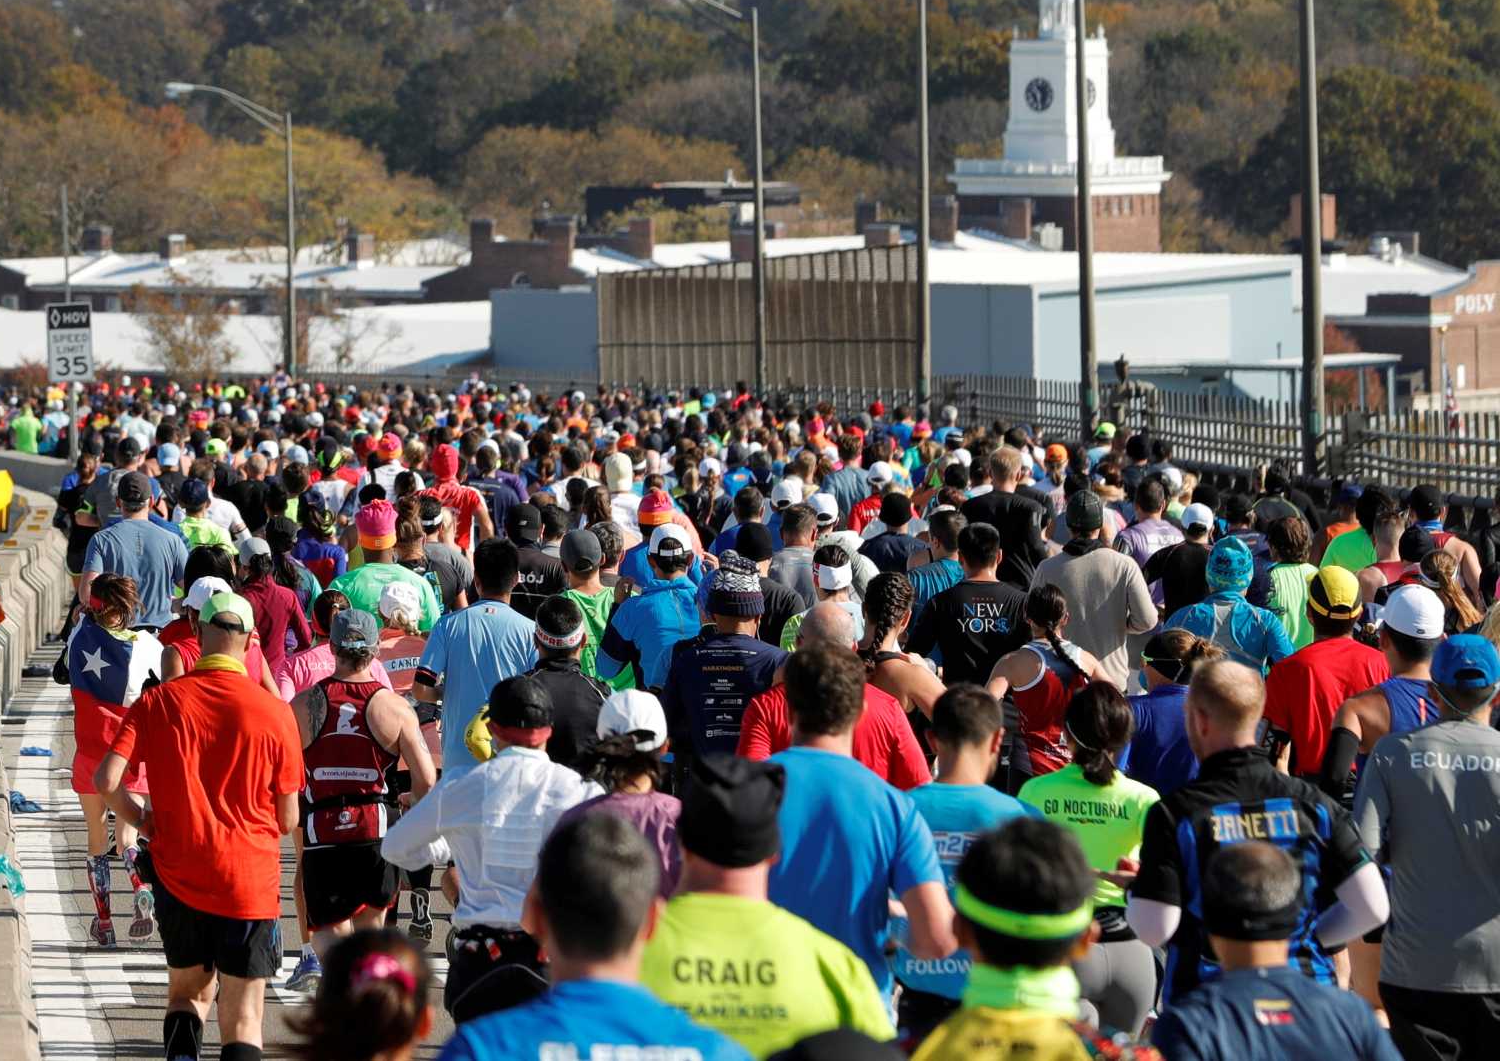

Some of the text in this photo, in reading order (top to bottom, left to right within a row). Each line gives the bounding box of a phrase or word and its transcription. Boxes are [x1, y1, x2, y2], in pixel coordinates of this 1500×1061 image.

[1454, 294, 1496, 315] POLY
[62, 312, 88, 323] HOV
[52, 334, 88, 343] SPEED
[56, 345, 84, 354] LIMIT
[56, 356, 88, 376] 35
[963, 603, 1004, 618] NEW
[1044, 799, 1130, 820] GO NOCTURNAL
[1210, 809, 1300, 841] ZANETTI
[673, 956, 777, 987] CRAIG
